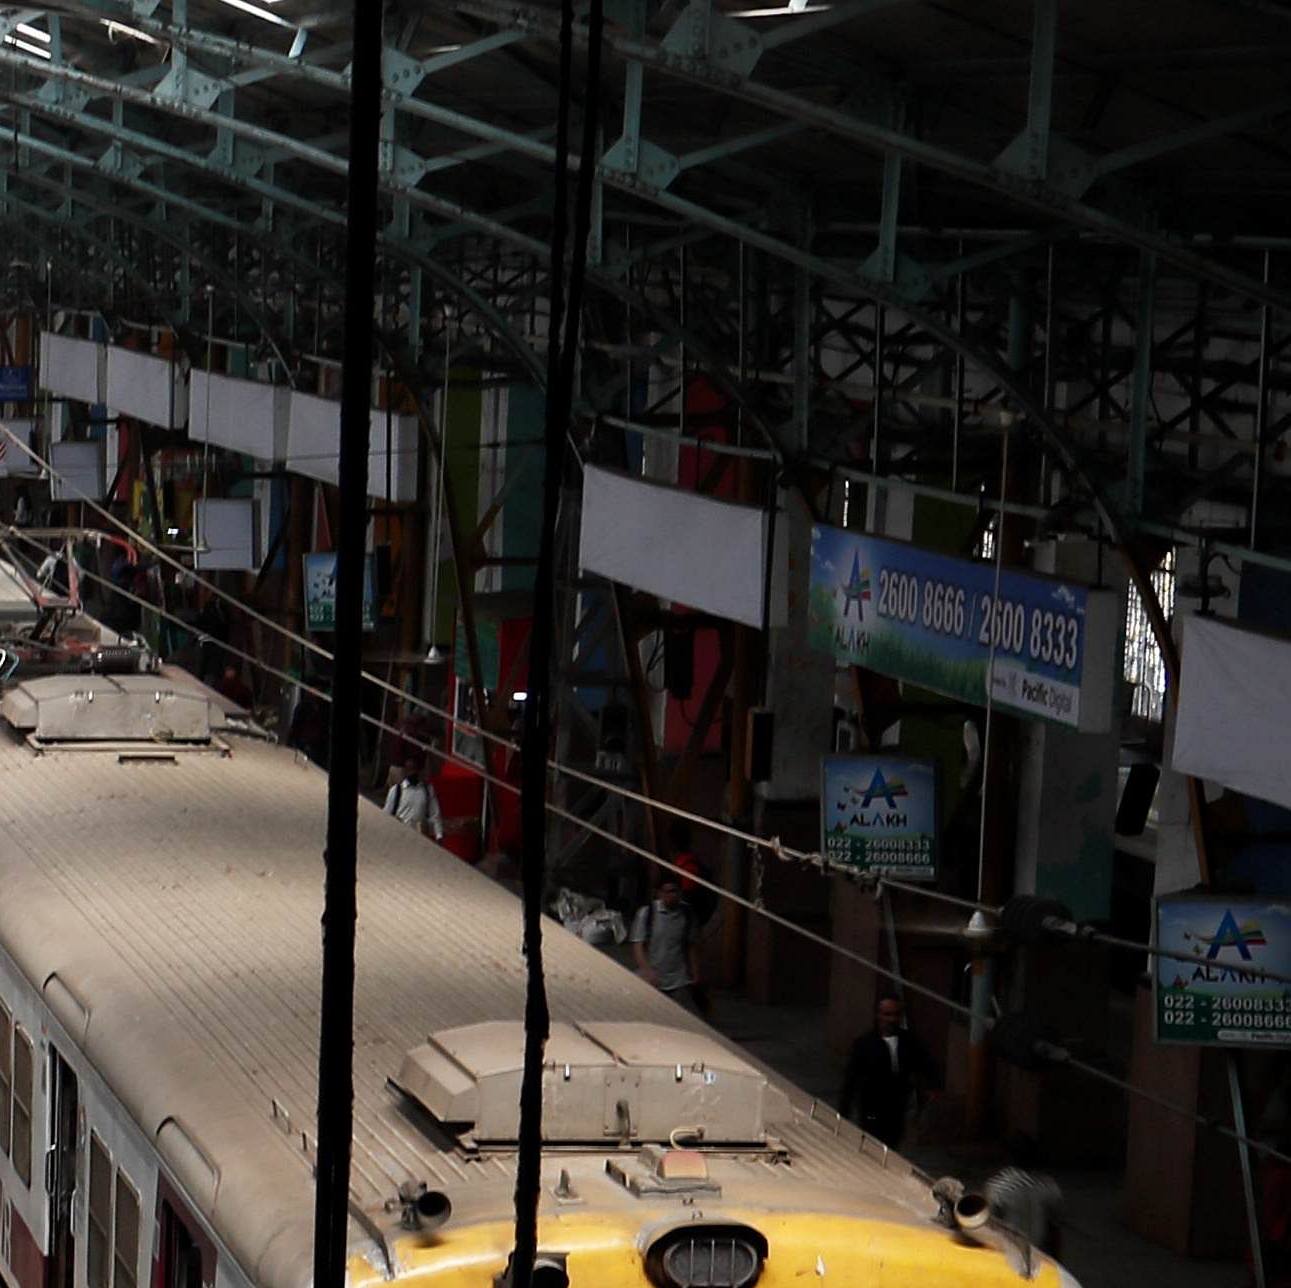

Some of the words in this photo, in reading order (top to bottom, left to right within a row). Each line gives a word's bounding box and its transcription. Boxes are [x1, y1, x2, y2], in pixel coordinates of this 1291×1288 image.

[877, 568, 918, 623] 2600
[922, 580, 965, 637] 8666
[979, 594, 1025, 654] 2600
[1030, 607, 1079, 671] 8333
[850, 812, 907, 827] ALAKH
[827, 836, 851, 850] 022
[1163, 994, 1195, 1009] 022
[1163, 1010, 1195, 1025] 022
